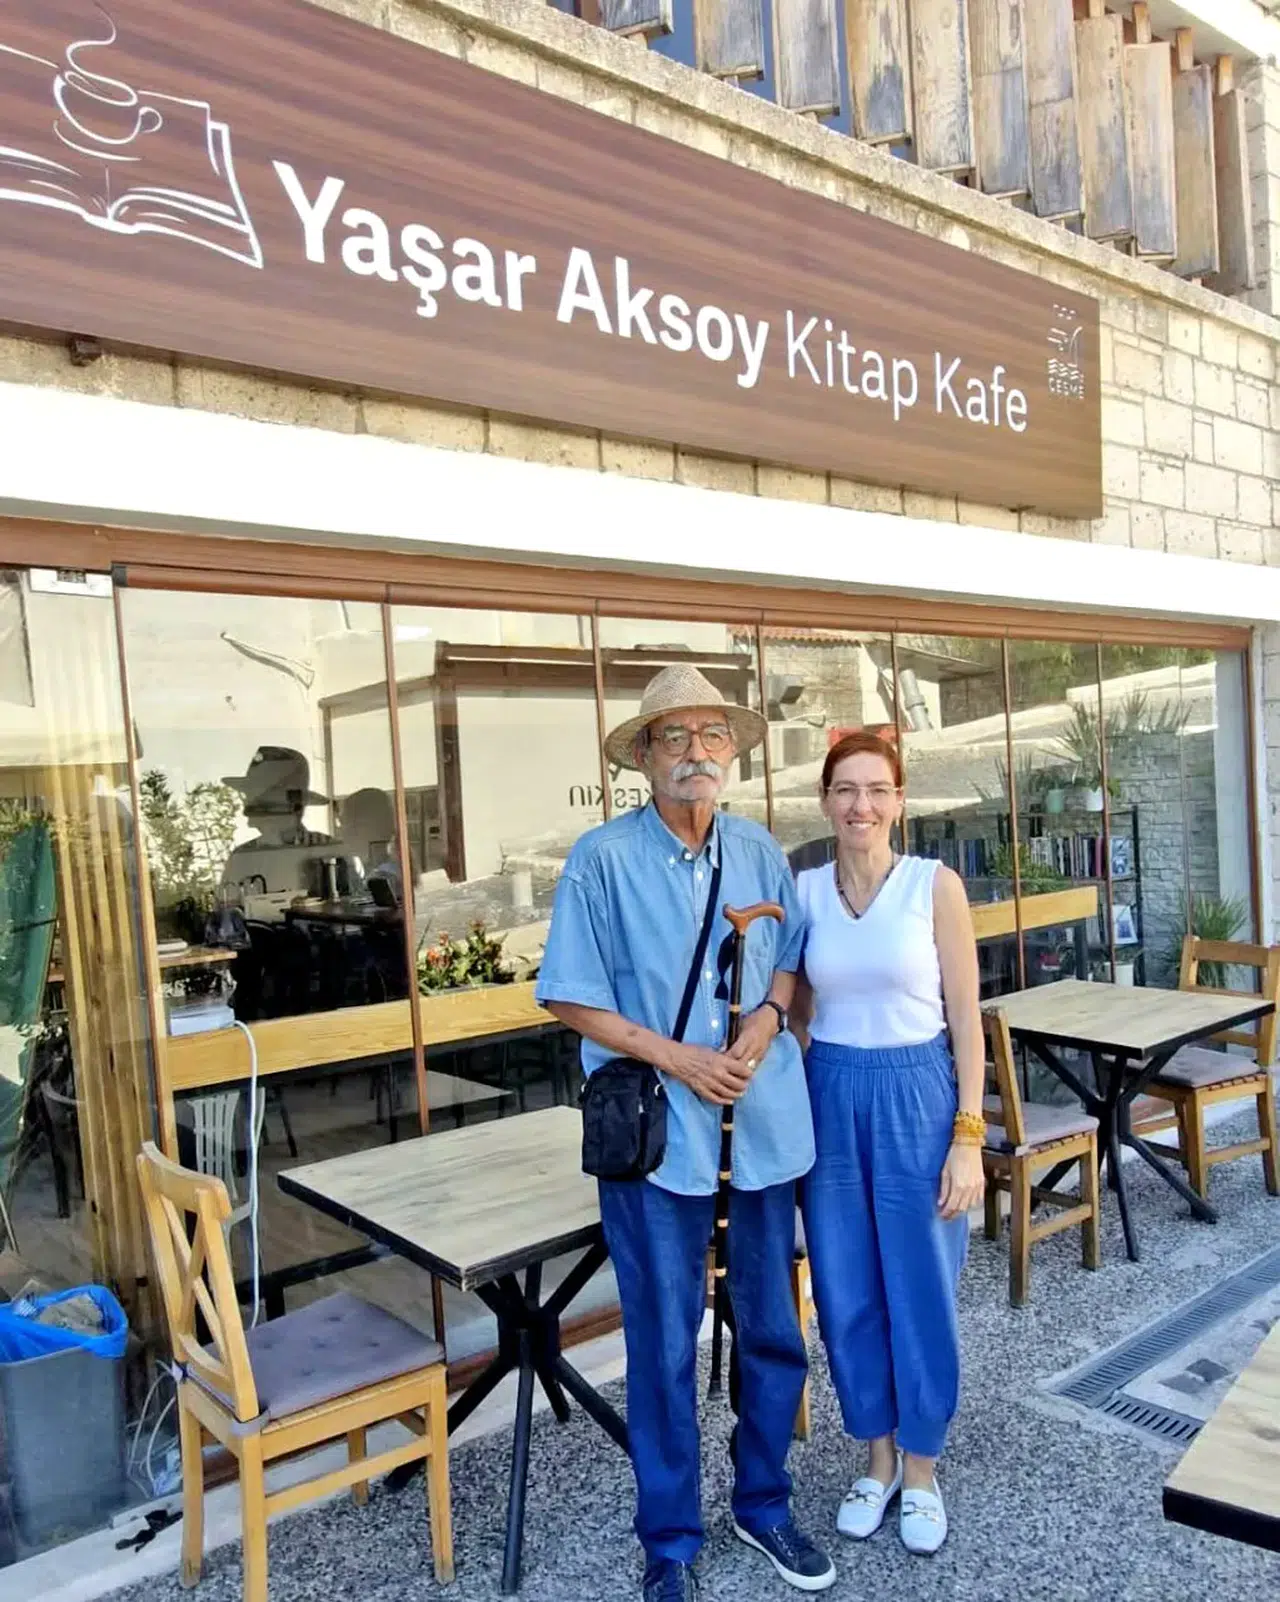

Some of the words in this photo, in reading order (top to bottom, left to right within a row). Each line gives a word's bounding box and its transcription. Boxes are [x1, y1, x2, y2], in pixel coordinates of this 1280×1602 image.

[272, 160, 537, 318] Yaşar
[556, 246, 770, 389] Aksoy
[785, 308, 918, 421] Kitap
[934, 352, 1027, 433] Kafe
